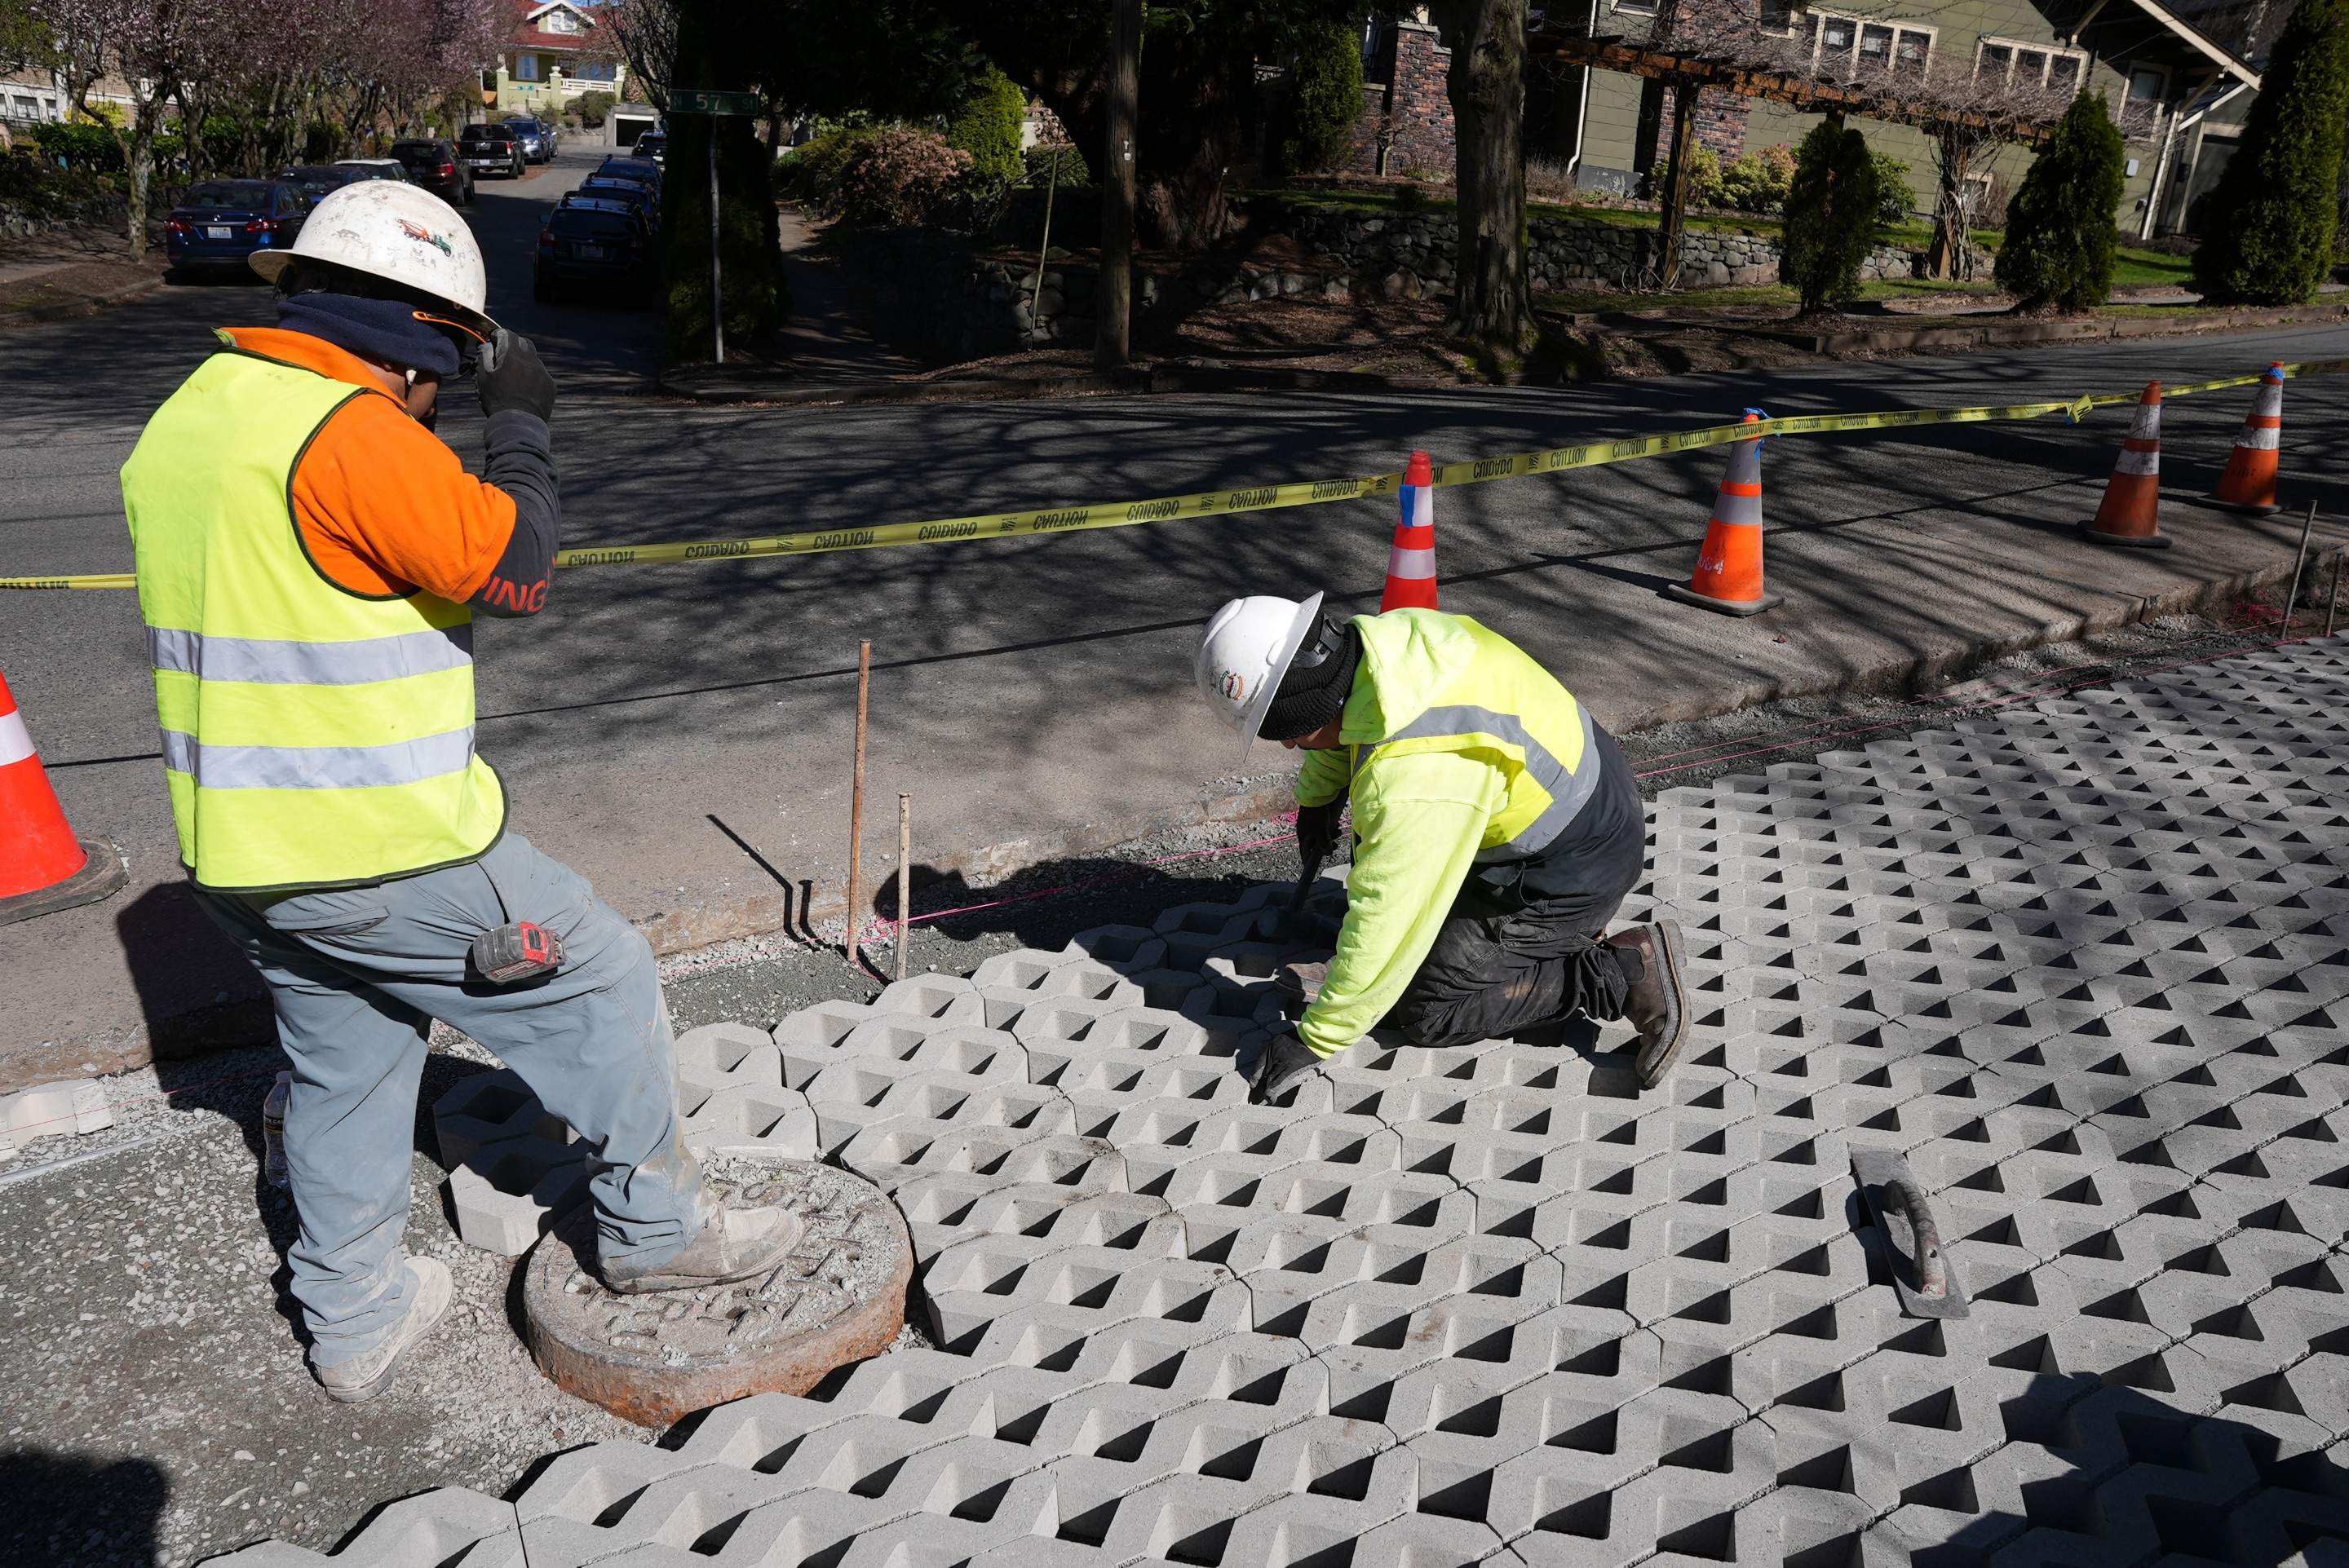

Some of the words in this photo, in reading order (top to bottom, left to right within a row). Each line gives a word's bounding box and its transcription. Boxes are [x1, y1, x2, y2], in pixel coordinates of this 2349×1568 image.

[674, 95, 682, 107] N
[696, 94, 721, 111] 57
[481, 576, 546, 612] ING
